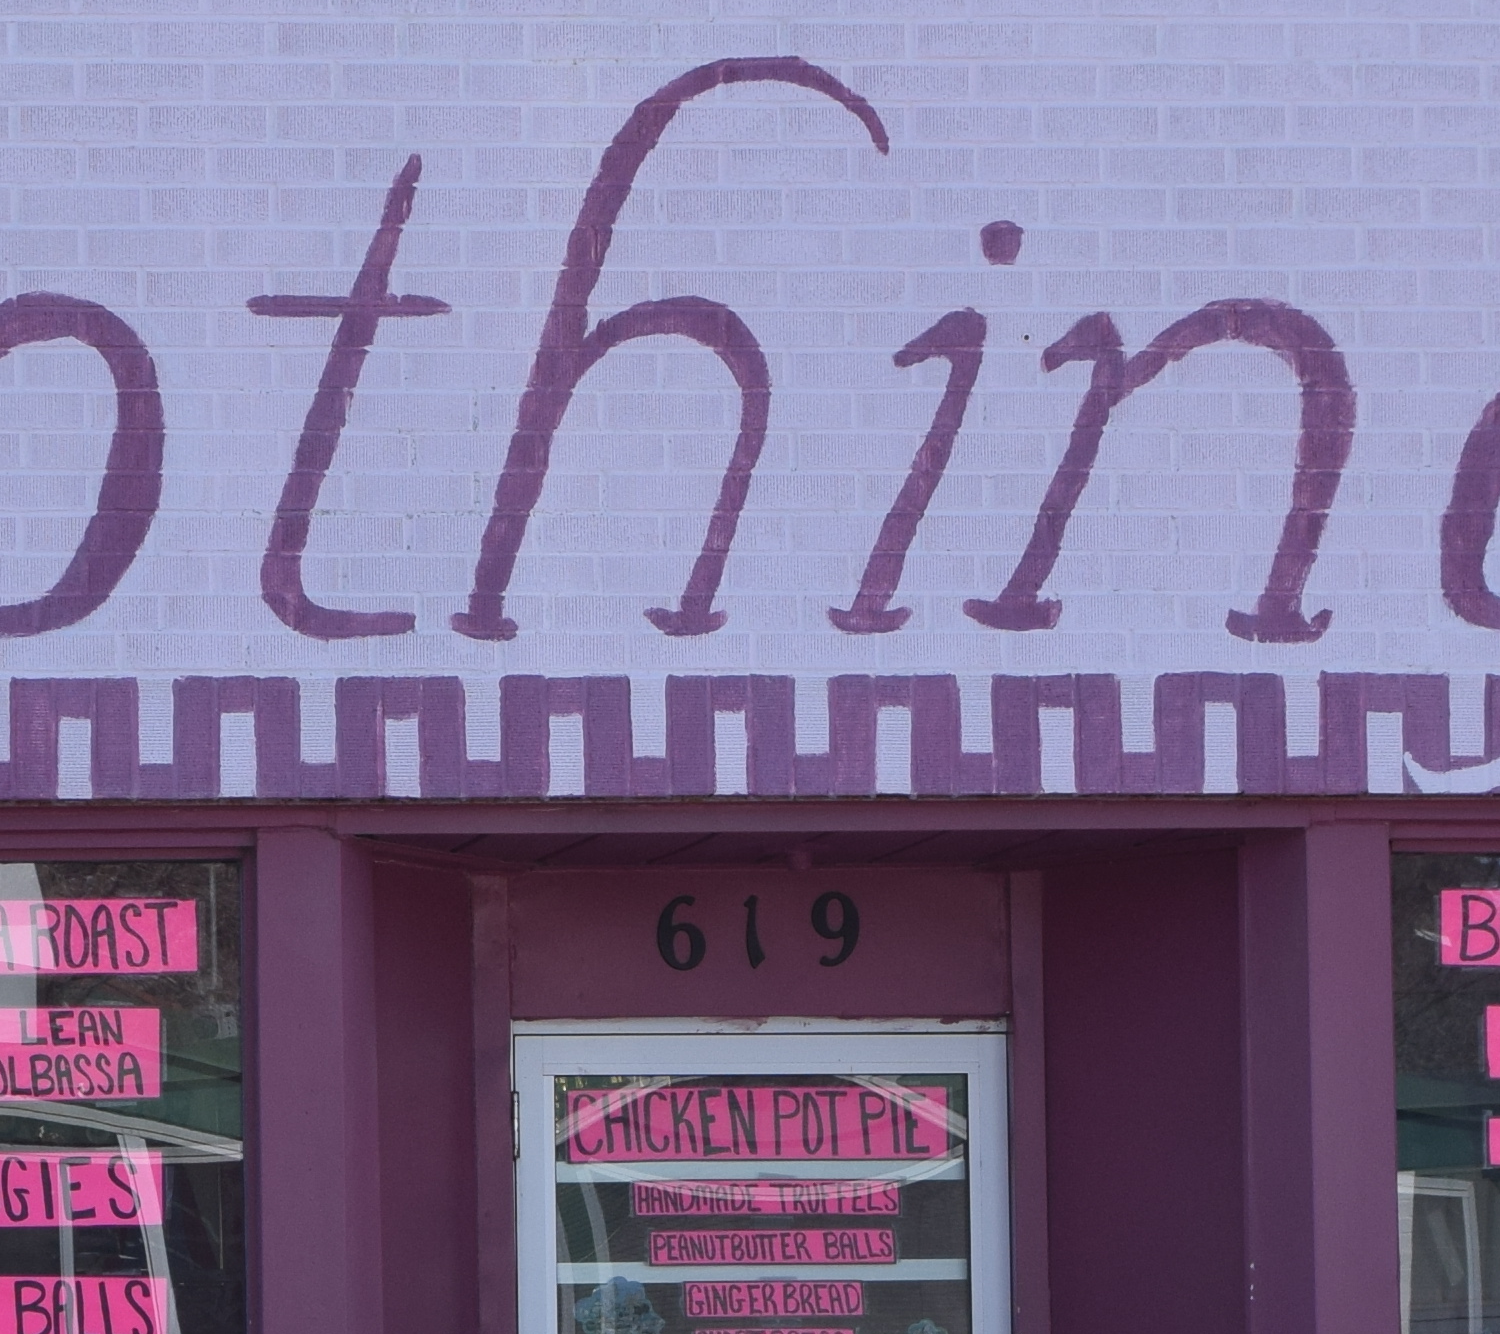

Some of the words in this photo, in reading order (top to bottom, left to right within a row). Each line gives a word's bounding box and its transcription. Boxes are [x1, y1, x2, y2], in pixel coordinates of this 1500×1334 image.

[30, 901, 181, 971] ROAST
[656, 892, 860, 971] 619
[19, 1010, 126, 1047] LEAN
[572, 1089, 758, 1156] CHICKEN
[774, 1091, 848, 1156] POT
[860, 1091, 930, 1155] PIE
[637, 1183, 762, 1214] HANDMADE
[770, 1182, 899, 1213] TRUFFELS
[823, 1231, 893, 1260] BALLS
